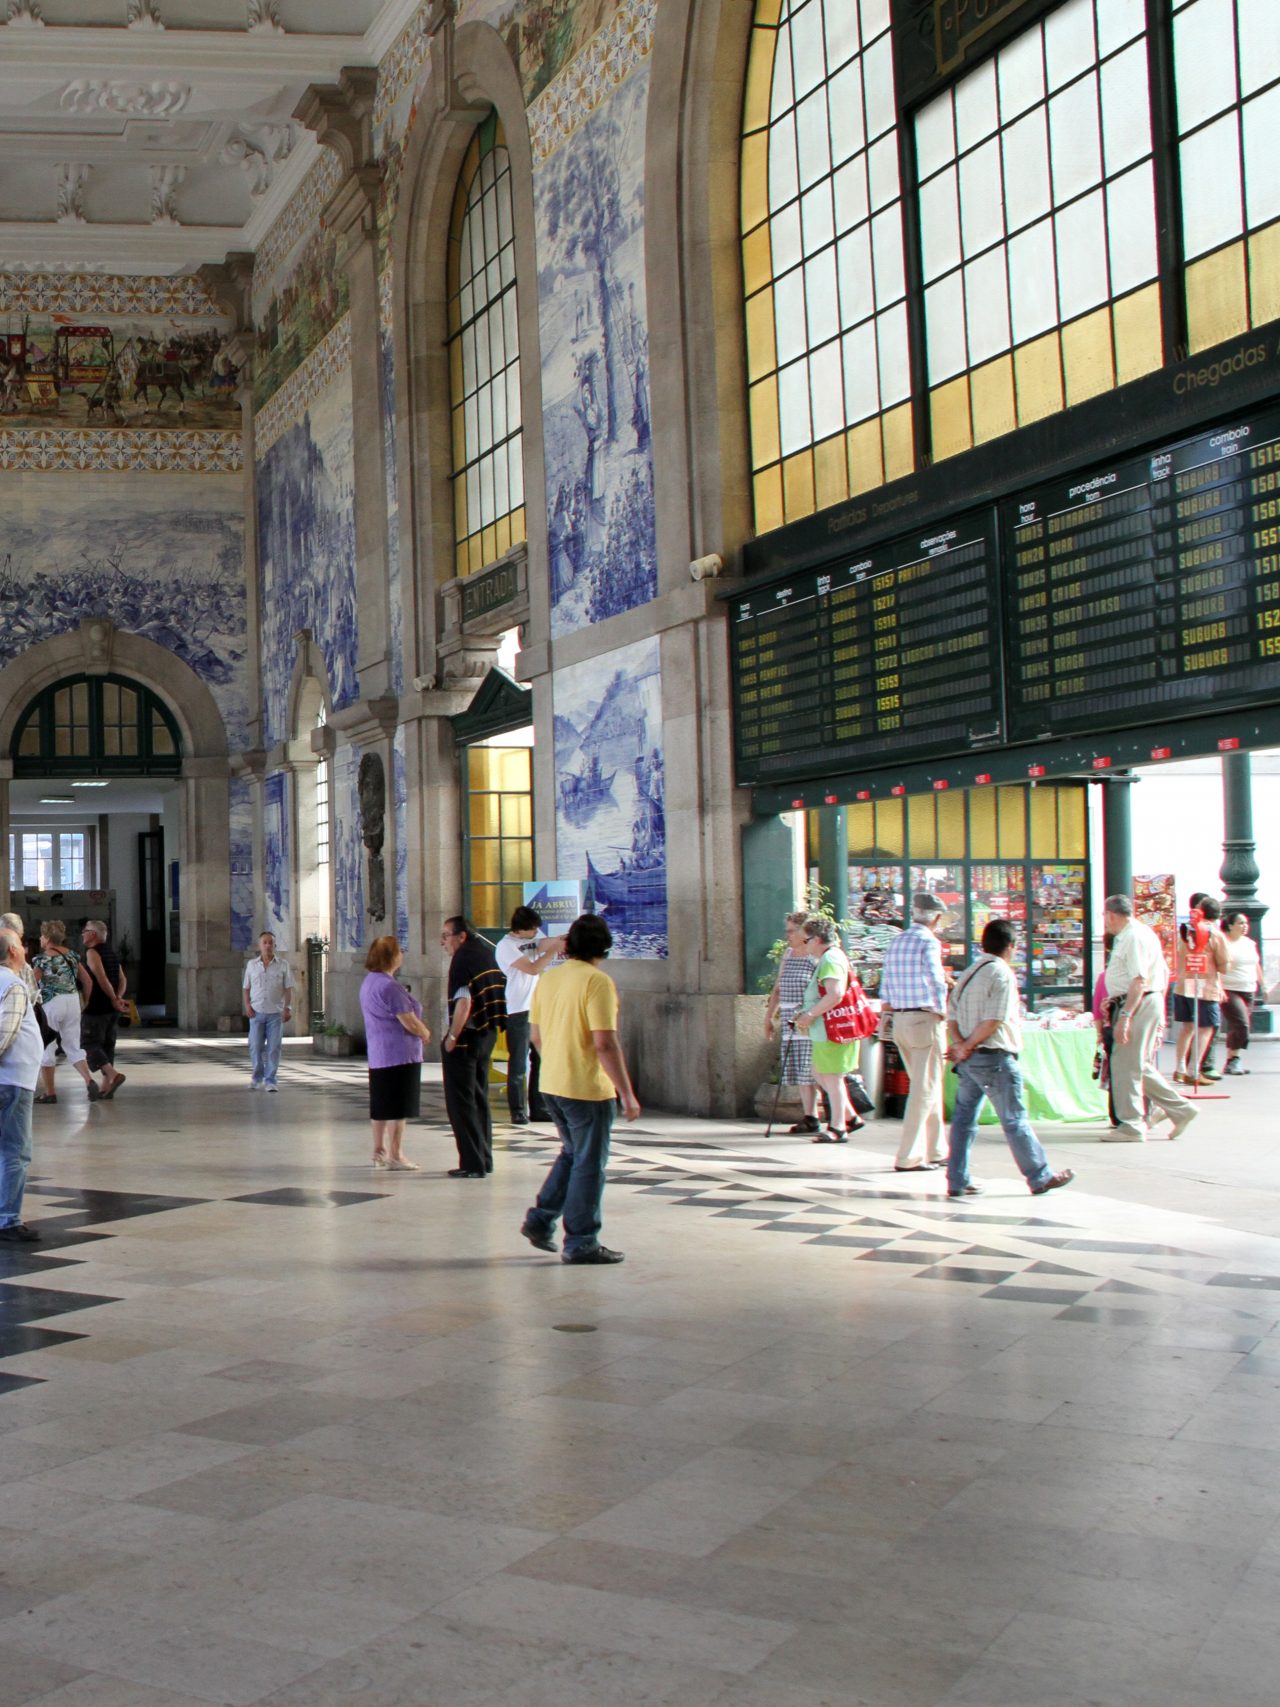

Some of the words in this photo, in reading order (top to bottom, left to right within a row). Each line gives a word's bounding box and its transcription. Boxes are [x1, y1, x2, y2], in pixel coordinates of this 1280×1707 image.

[1173, 343, 1266, 394] Chegadas
[1209, 425, 1250, 447] comboio
[1221, 443, 1238, 455] train
[1151, 453, 1171, 469] linha
[1069, 473, 1116, 499] procedência
[1176, 464, 1219, 493] SUBURB
[1019, 502, 1035, 514] hora
[1177, 490, 1220, 519] SUBURB
[827, 507, 867, 535] Partidas
[1178, 516, 1221, 544] SUBURB
[1179, 542, 1222, 569] SUBURB
[464, 568, 513, 613] ENTRADA
[1180, 568, 1223, 594] SUBURB
[1181, 595, 1225, 620] SUBURB
[1182, 621, 1226, 646] SUBURB
[1183, 647, 1228, 672] SUBURB
